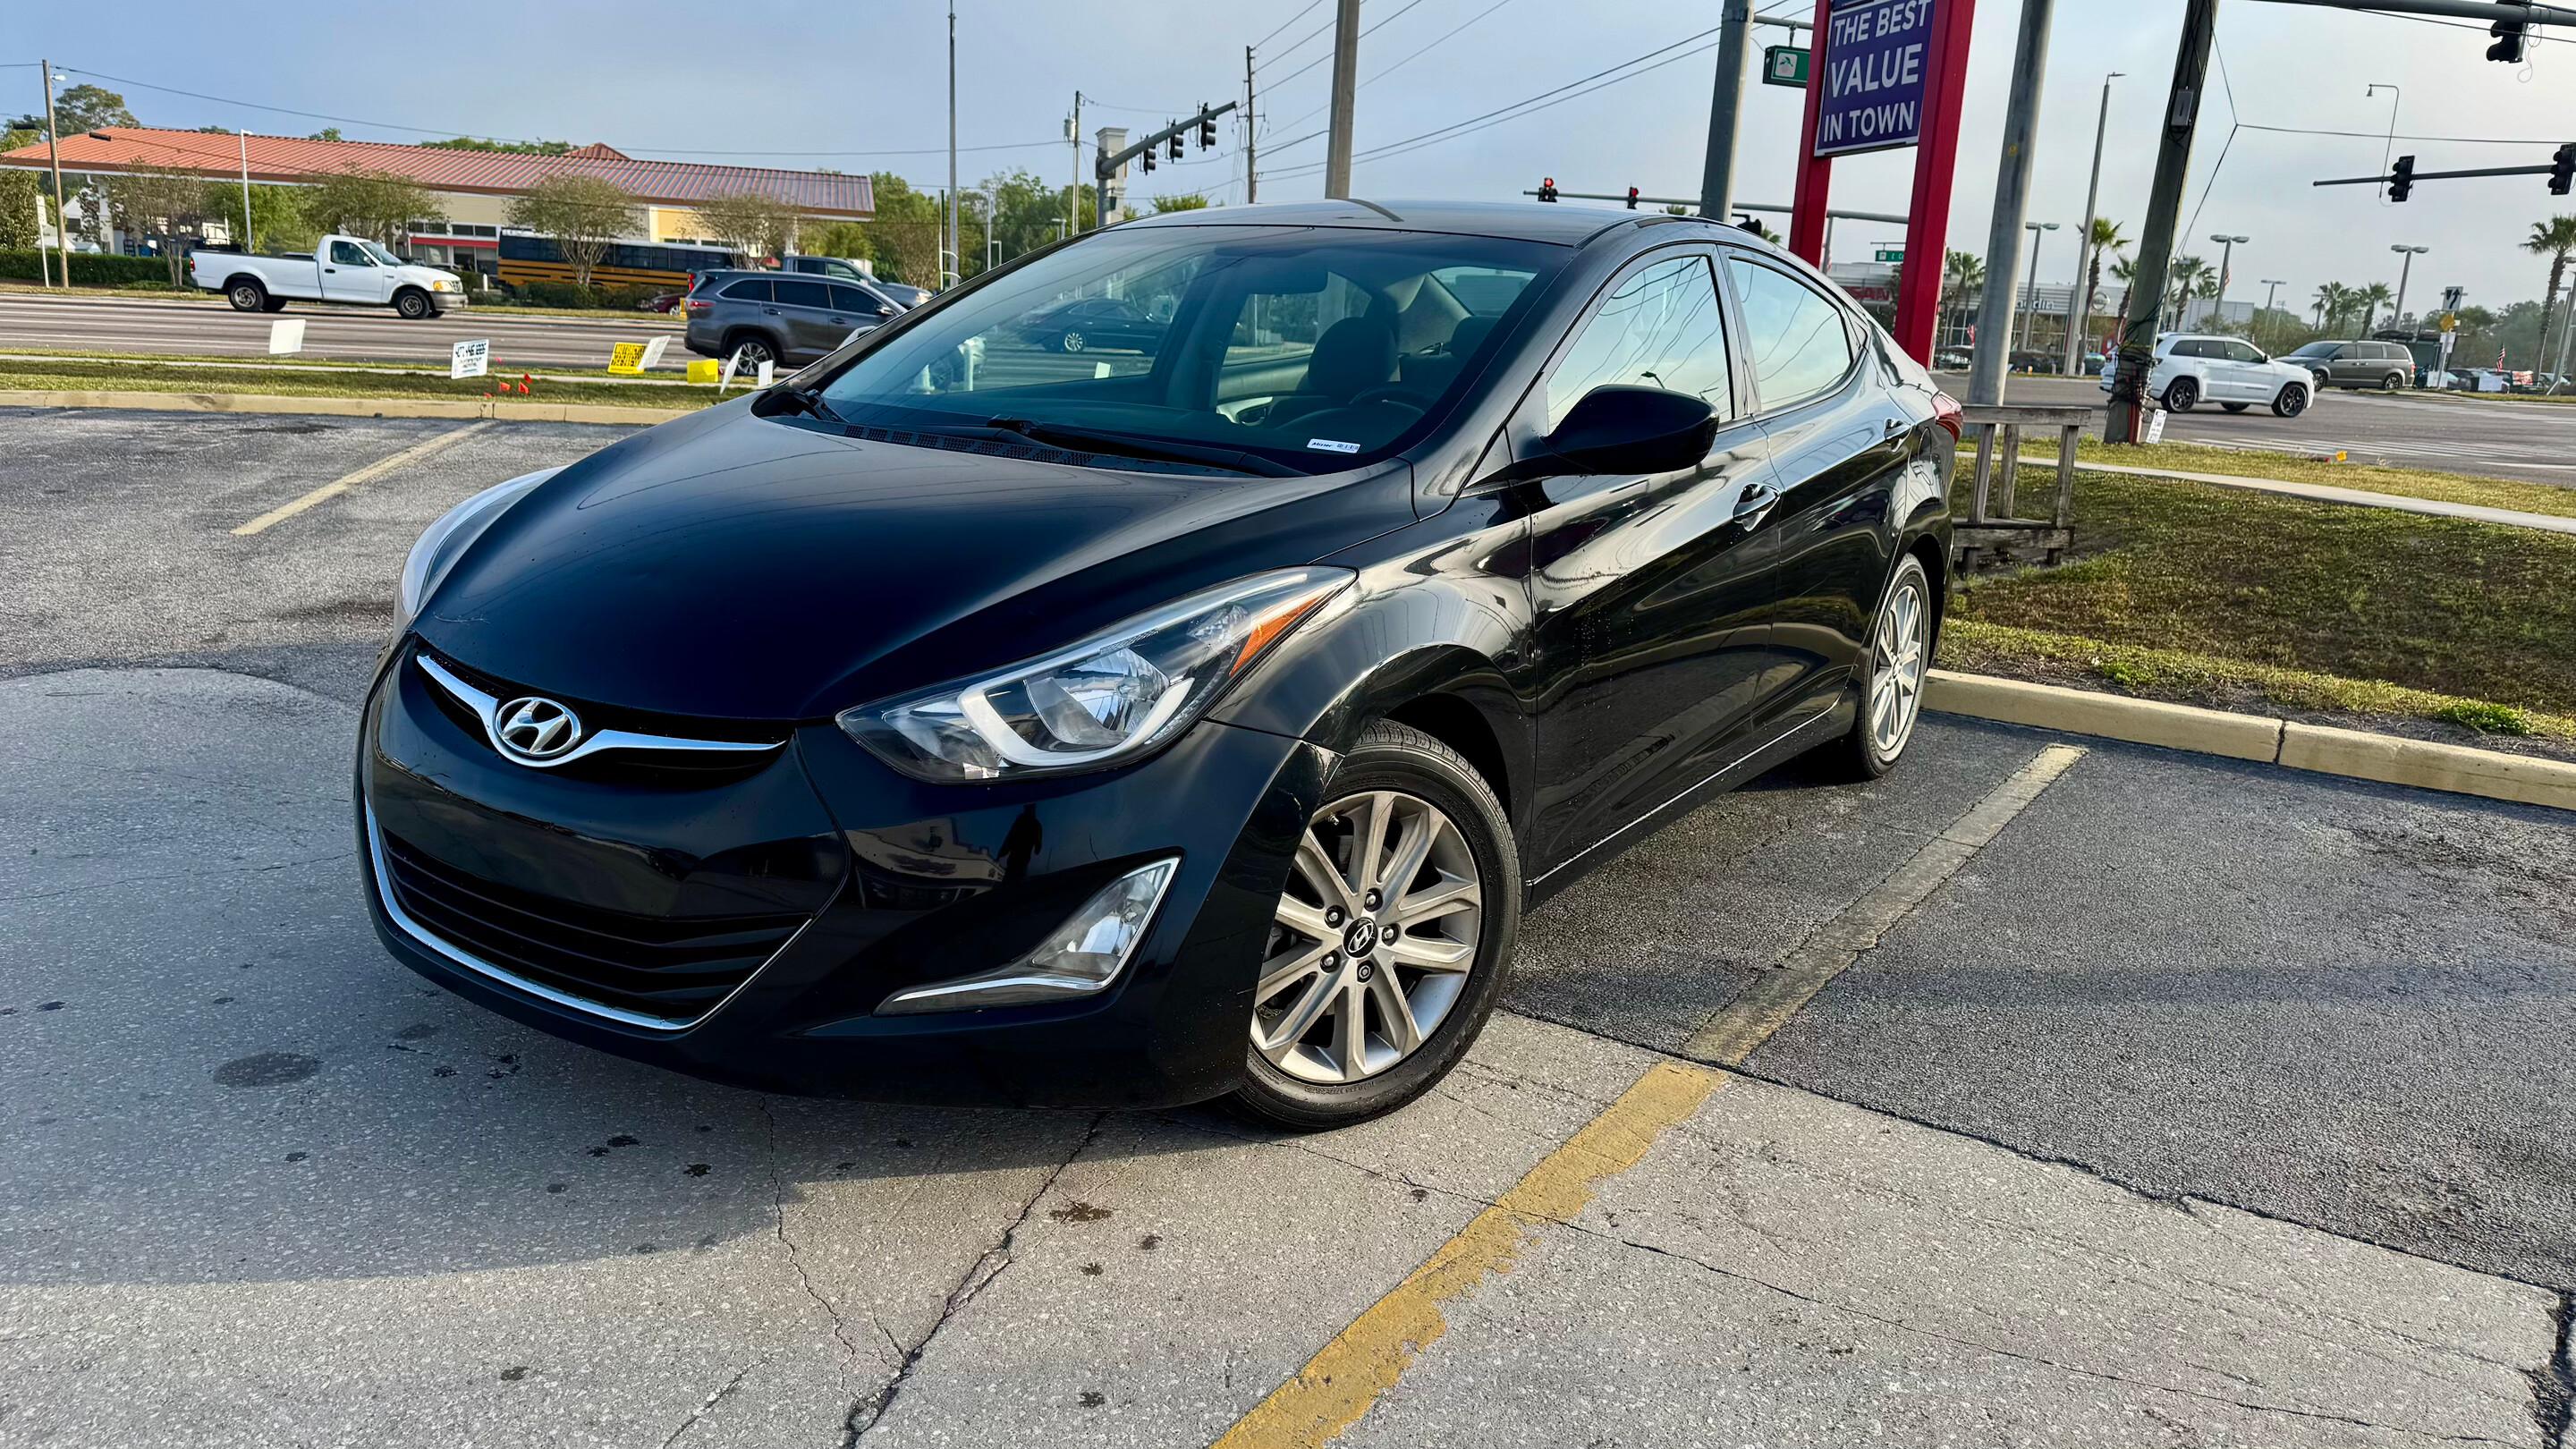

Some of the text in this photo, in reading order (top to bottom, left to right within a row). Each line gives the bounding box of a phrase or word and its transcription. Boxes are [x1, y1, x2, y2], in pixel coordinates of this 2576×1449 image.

[1835, 0, 1931, 47] THE BEST
[1831, 43, 1922, 97] VALUE
[1824, 101, 1915, 142] IN TOWN
